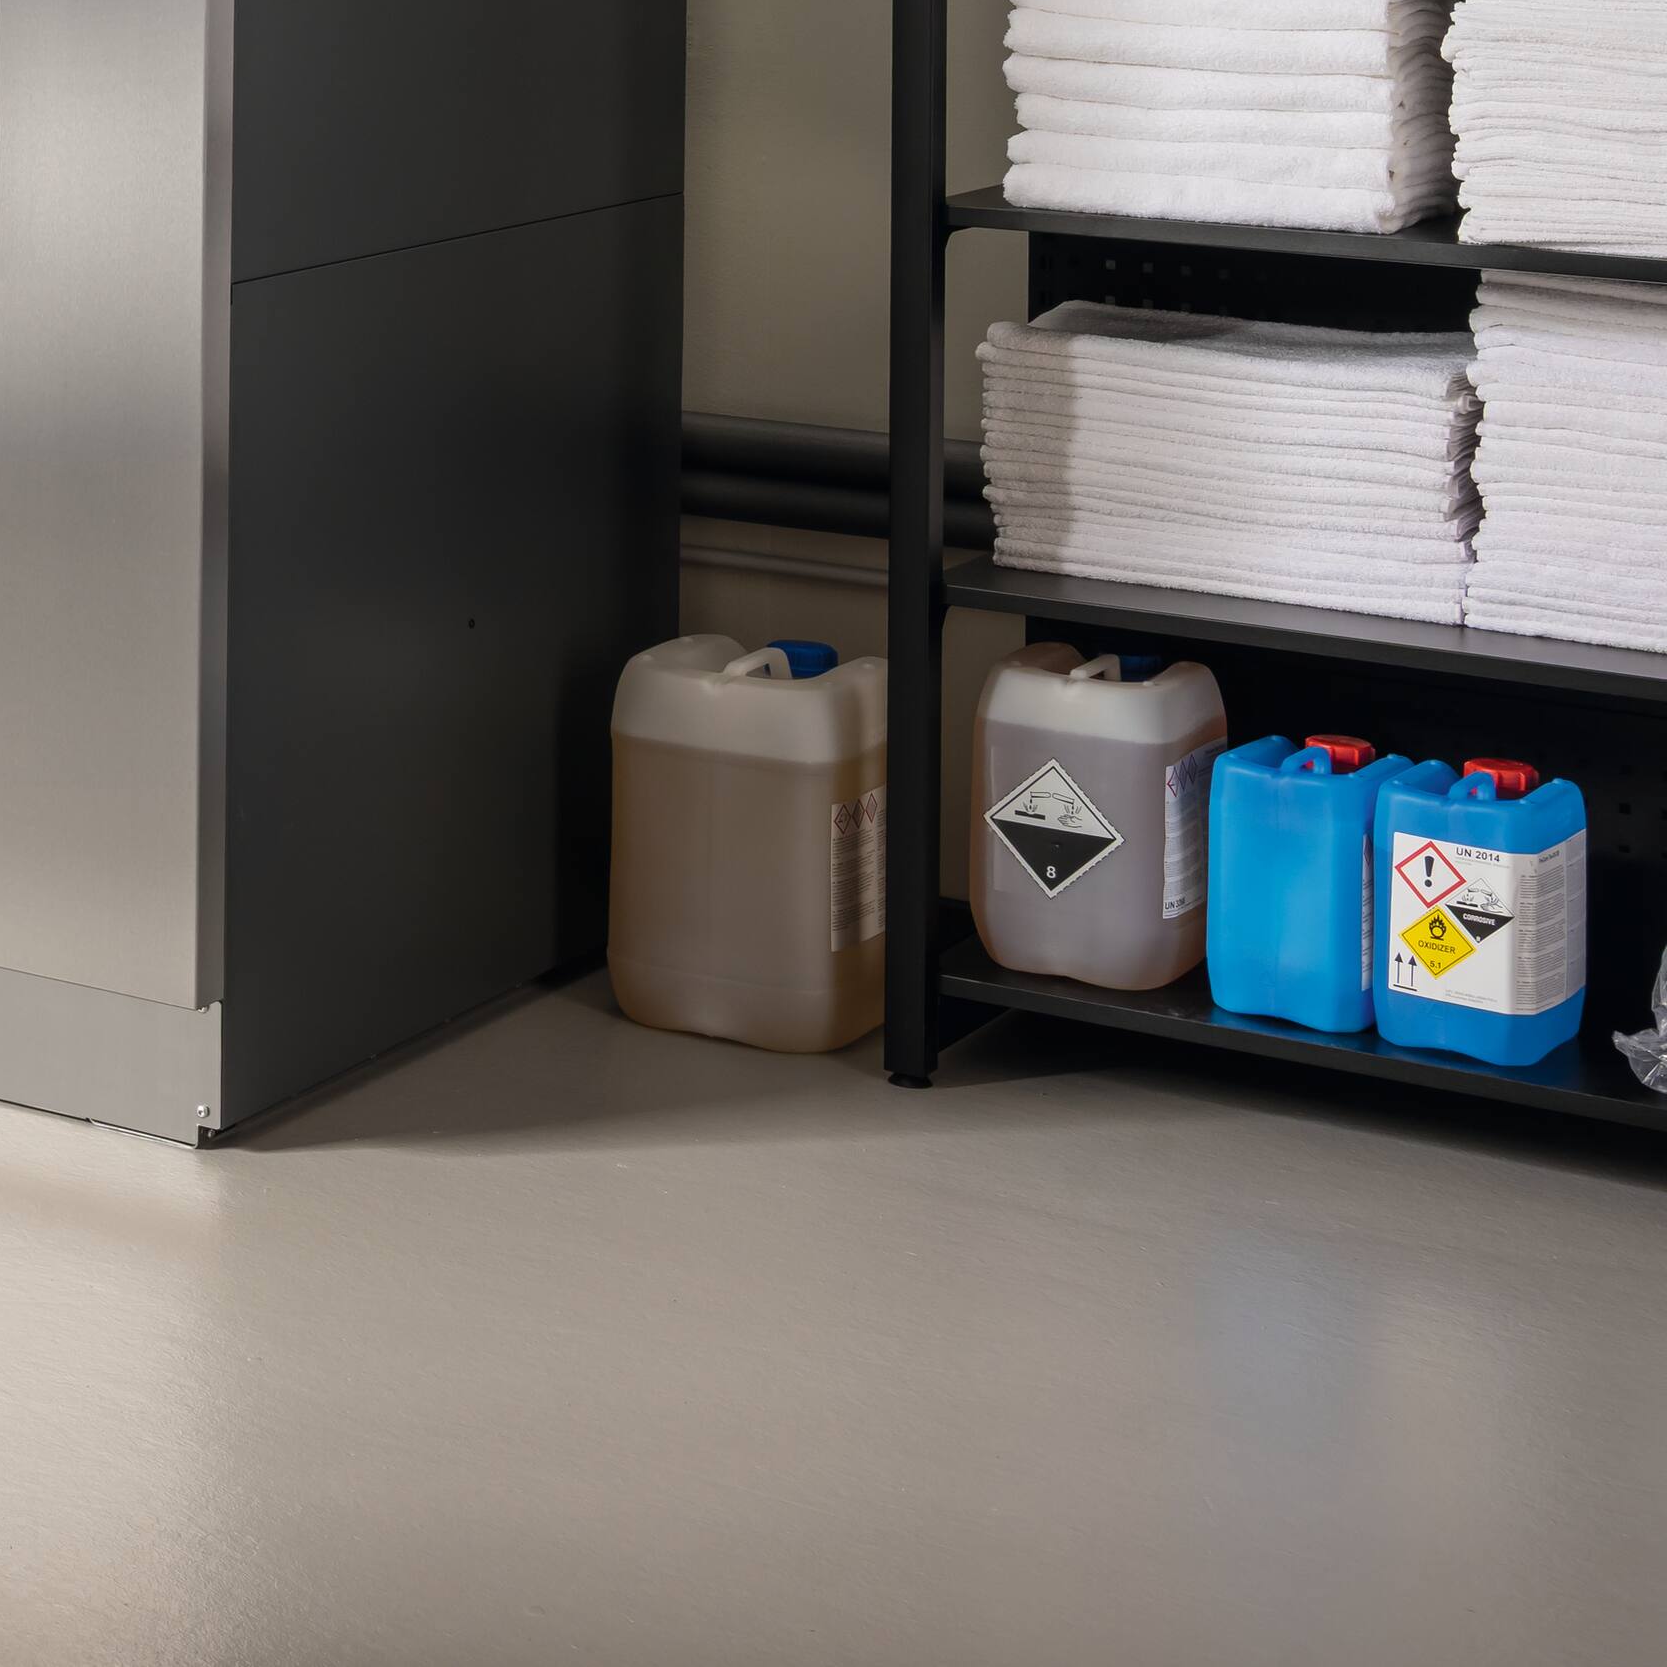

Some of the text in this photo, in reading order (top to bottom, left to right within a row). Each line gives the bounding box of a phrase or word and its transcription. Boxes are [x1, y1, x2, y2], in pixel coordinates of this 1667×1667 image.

[1456, 847, 1500, 863] UN 2014
[1046, 865, 1056, 879] 8
[1462, 913, 1496, 926] CORROSIVE
[1418, 940, 1456, 955] OXIDIZER
[1430, 960, 1442, 969] 5.1
